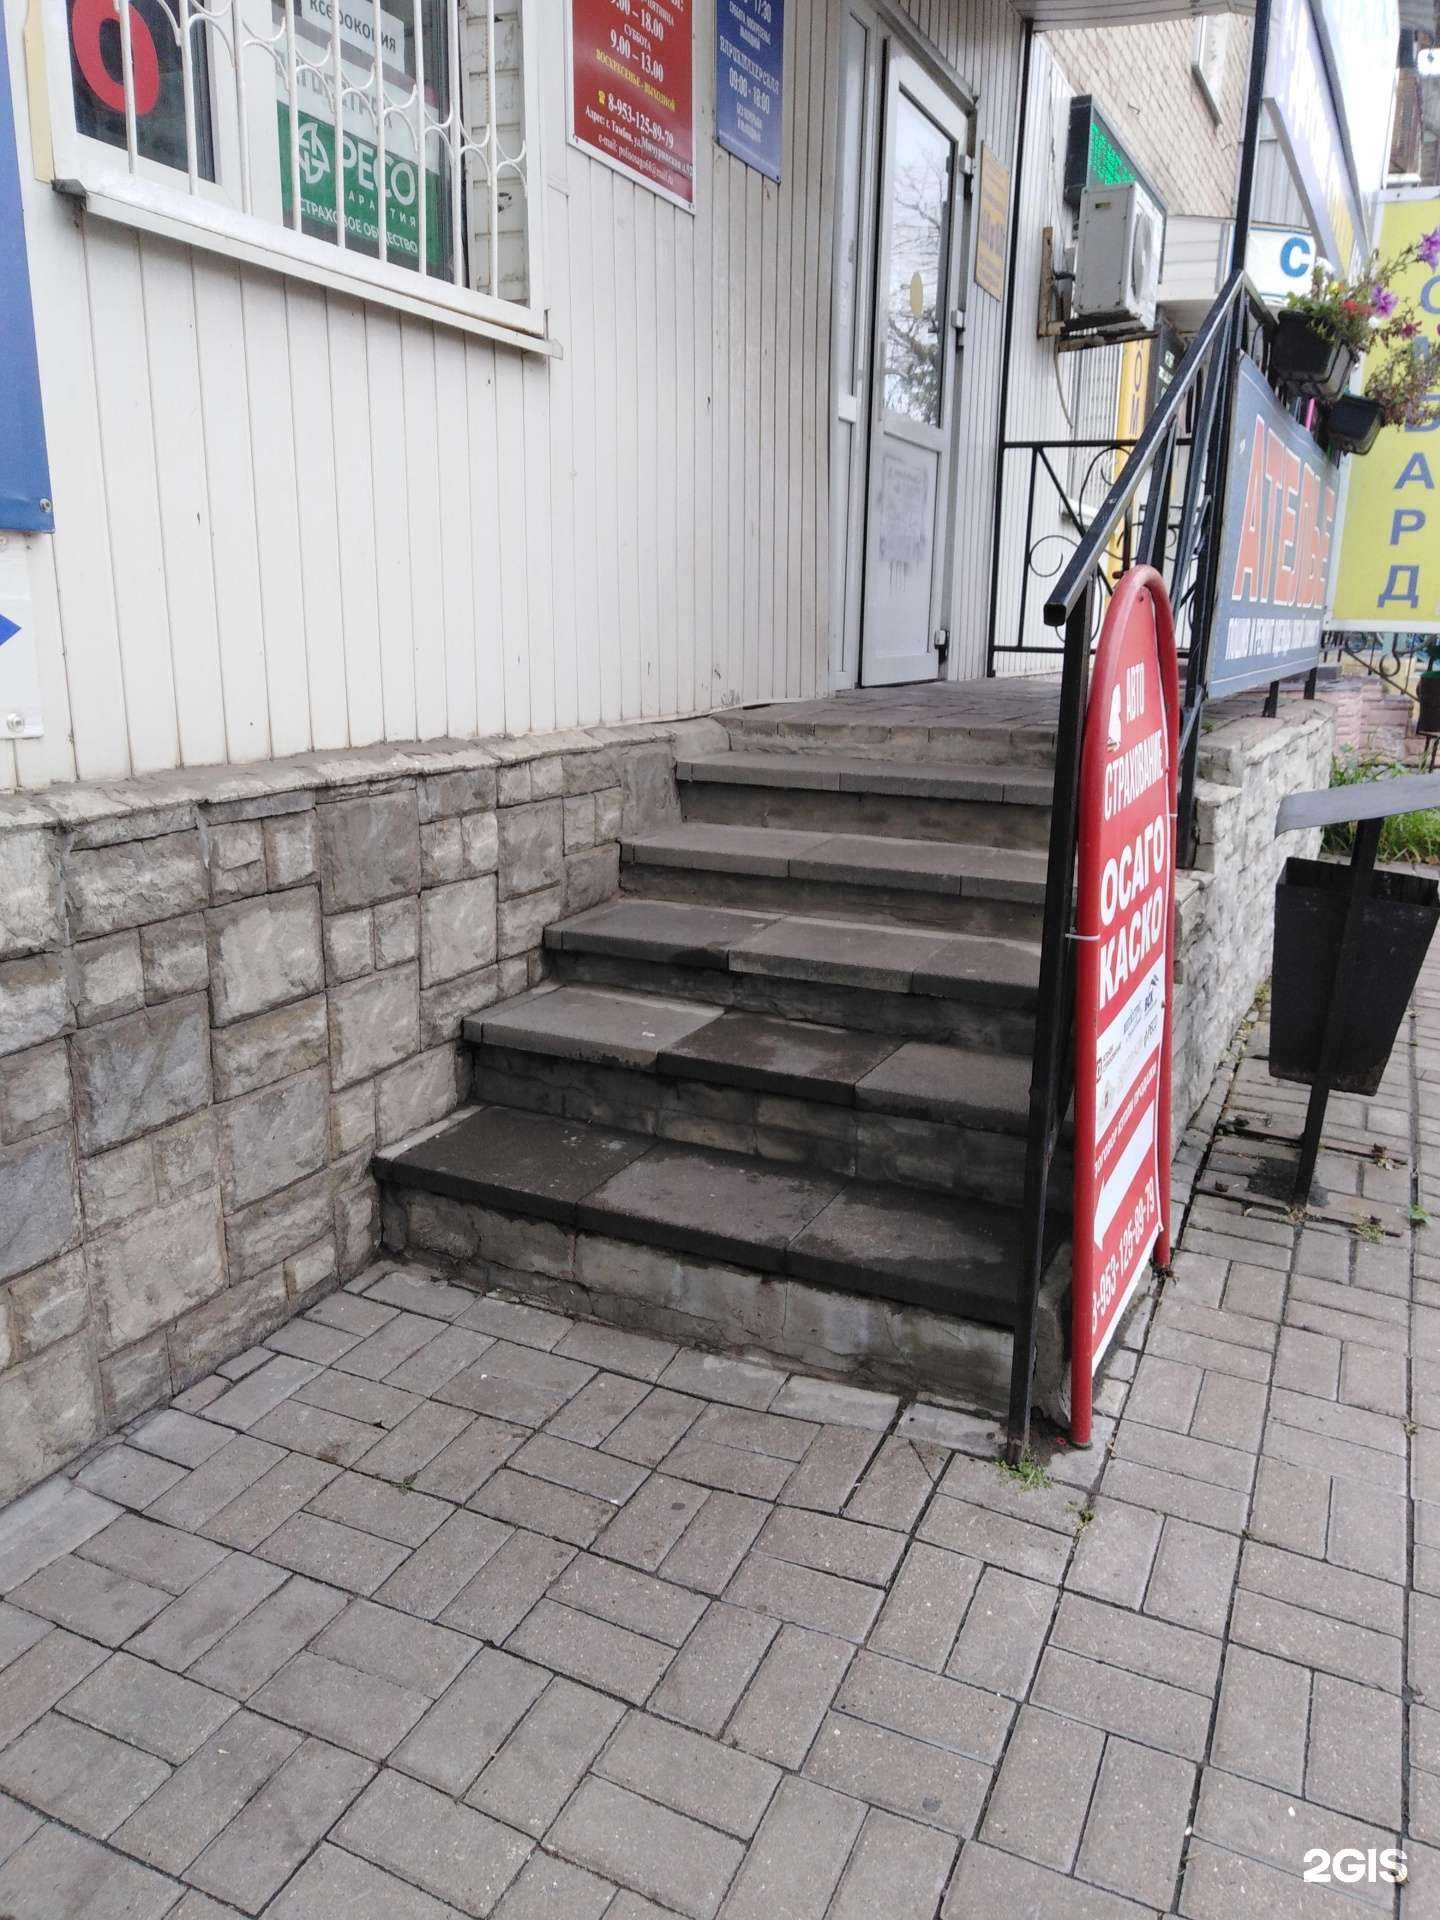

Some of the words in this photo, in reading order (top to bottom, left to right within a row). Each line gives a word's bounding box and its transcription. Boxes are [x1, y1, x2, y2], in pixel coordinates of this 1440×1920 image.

[610, 29, 631, 59] 9.00
[641, 51, 664, 82] 13.00
[608, 92, 675, 149] 8-953-125-89-79
[1232, 413, 1335, 609] АТЕЛЬЕ
[1126, 662, 1145, 723] АВТО
[1104, 728, 1164, 821] СТРАХОВАНИЕ
[1100, 815, 1165, 926] ОСАГО
[1100, 886, 1163, 1012] КАСКО
